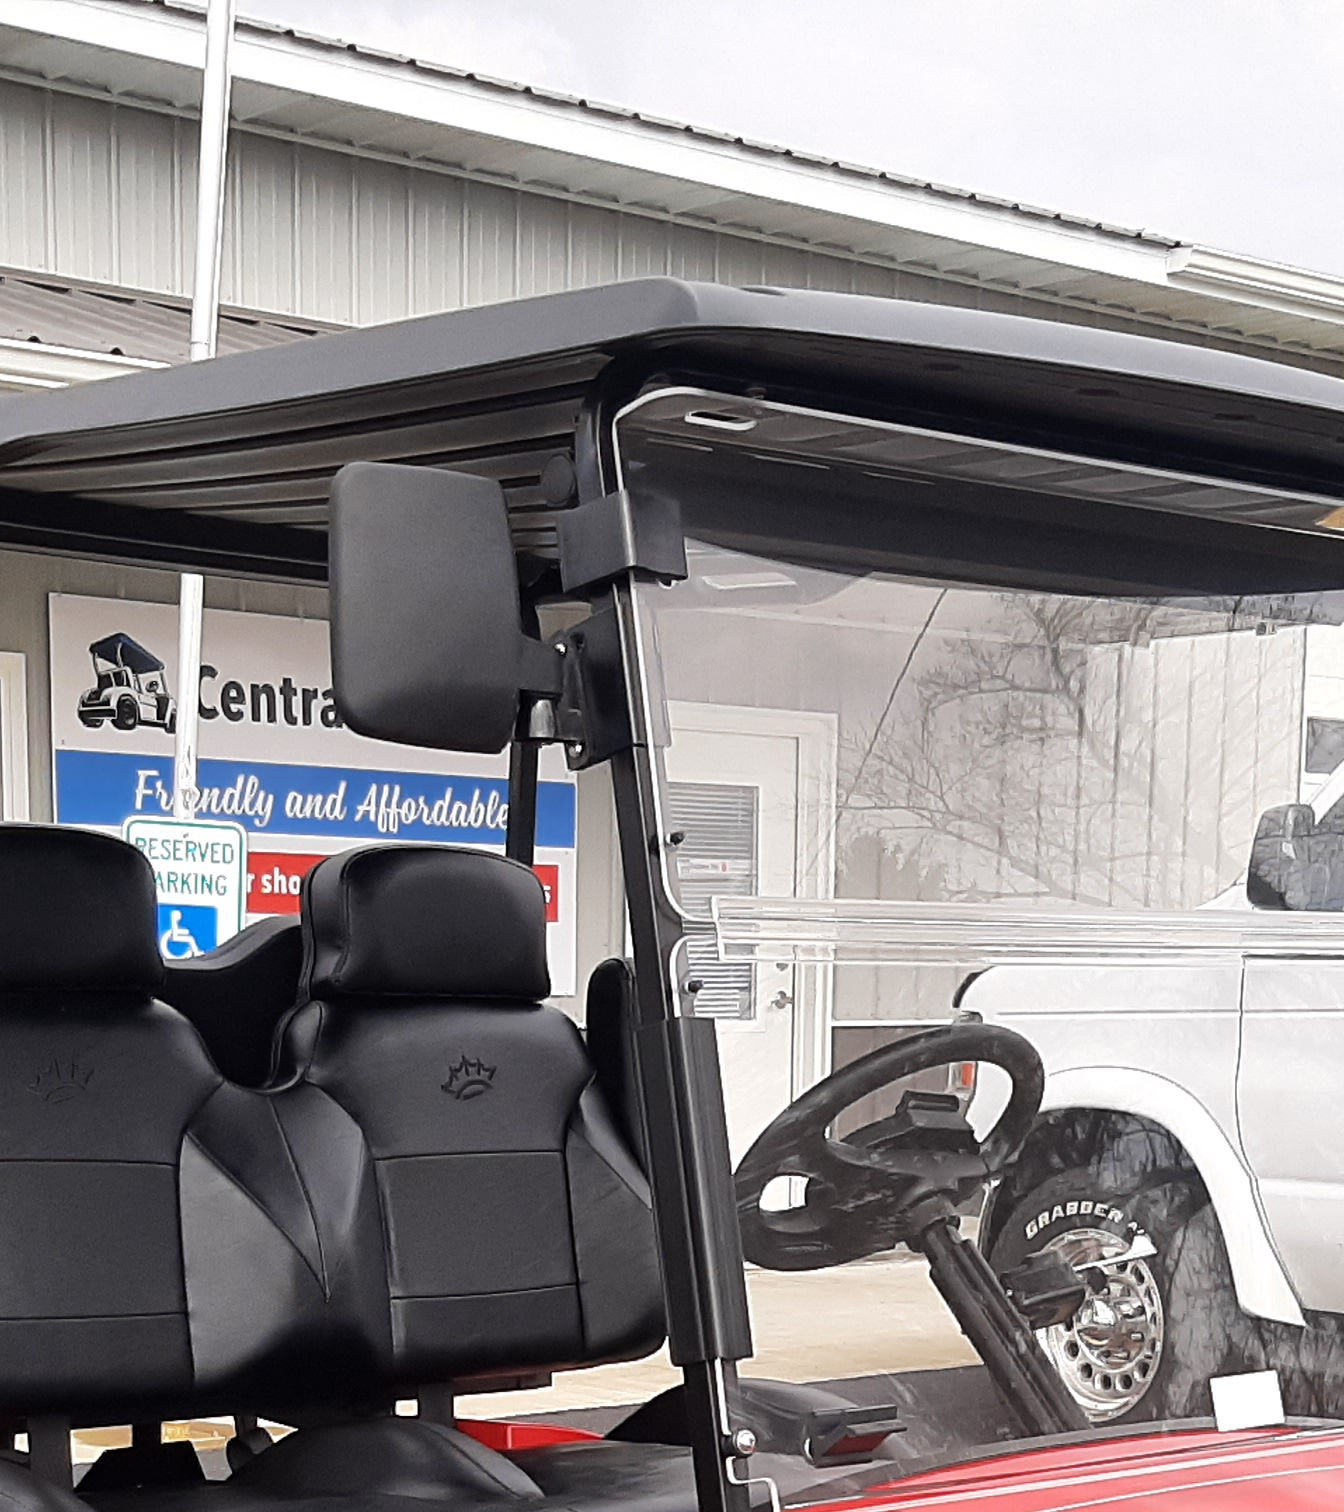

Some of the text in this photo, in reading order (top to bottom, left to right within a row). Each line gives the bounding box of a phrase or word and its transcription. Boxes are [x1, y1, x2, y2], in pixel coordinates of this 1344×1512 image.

[198, 664, 345, 729] Centra
[135, 769, 508, 834] Frndly and Affordable
[135, 837, 234, 865] RESERVED
[155, 871, 228, 896] ARKING
[261, 867, 301, 895] sho
